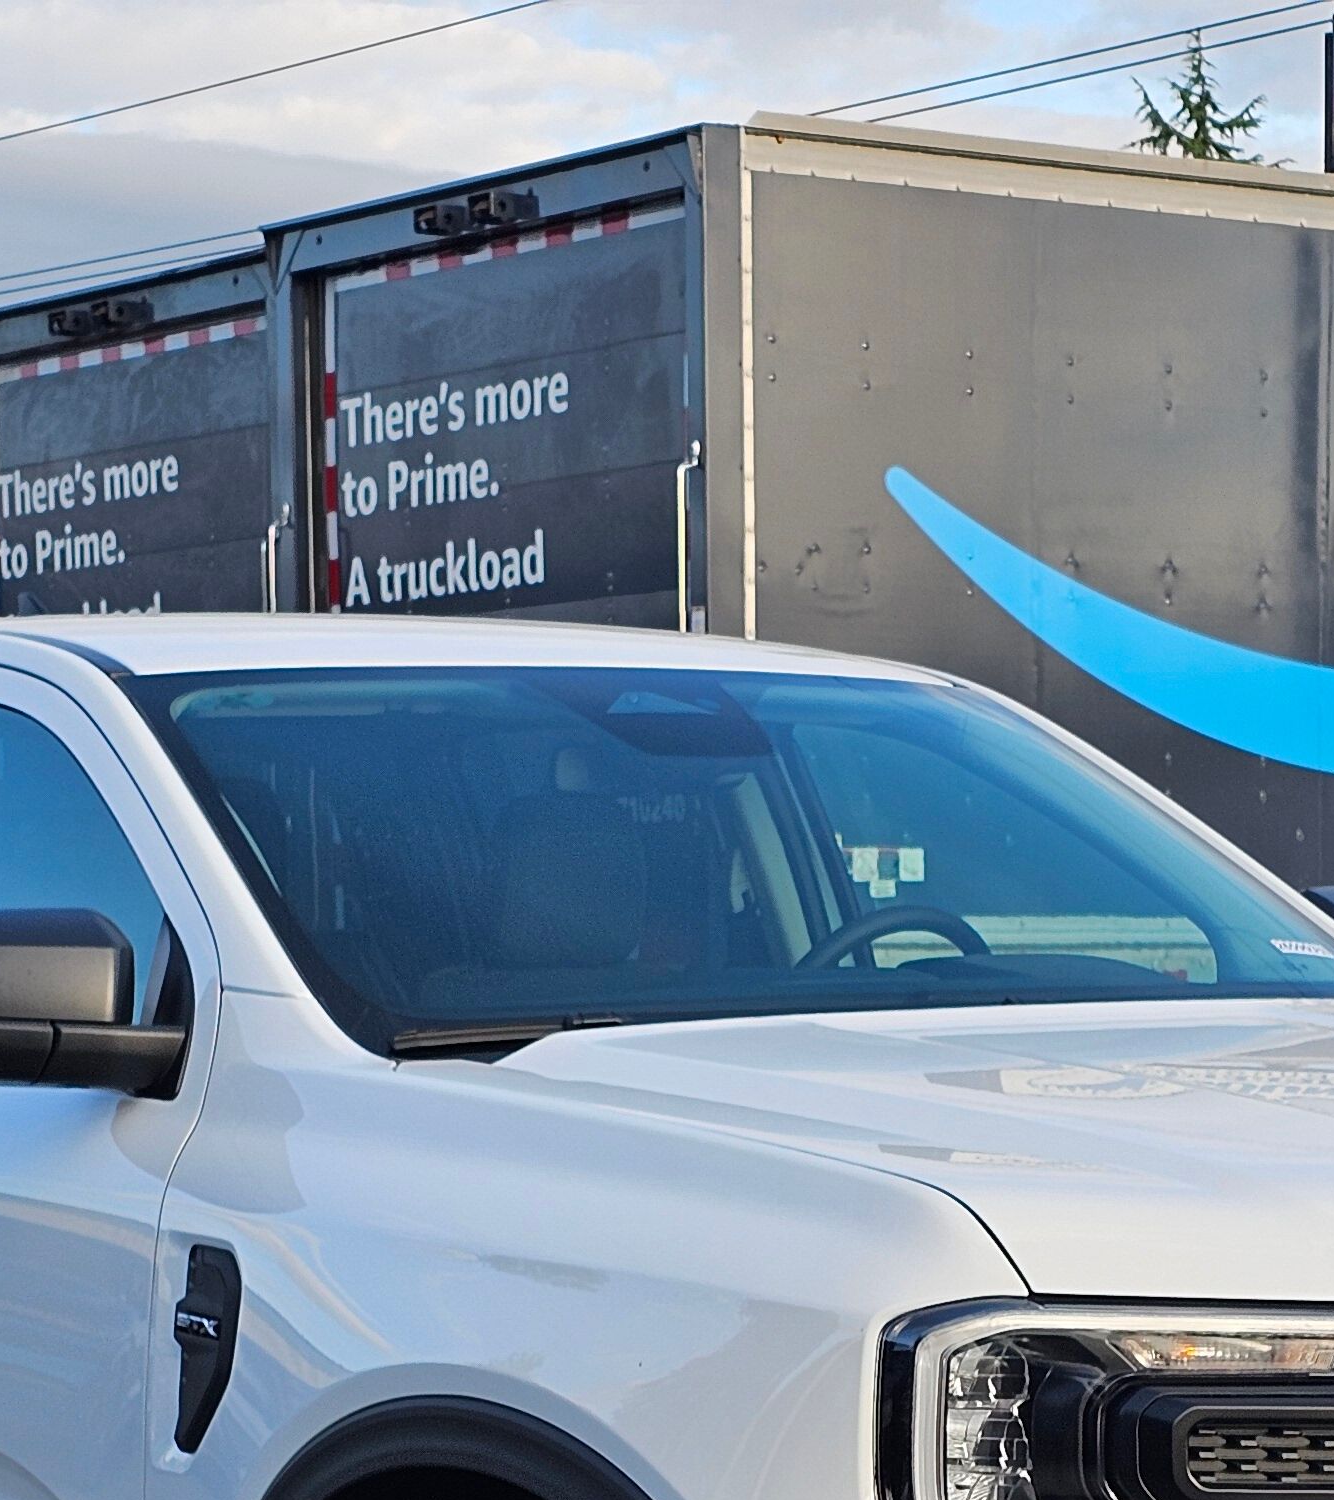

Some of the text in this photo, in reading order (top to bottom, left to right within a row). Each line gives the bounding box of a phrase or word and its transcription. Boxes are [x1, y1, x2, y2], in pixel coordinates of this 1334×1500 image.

[340, 372, 569, 447] There's more
[103, 455, 179, 502] more
[342, 452, 499, 518] to Prime.
[0, 523, 125, 580] to Prime.
[347, 528, 545, 607] A truckload
